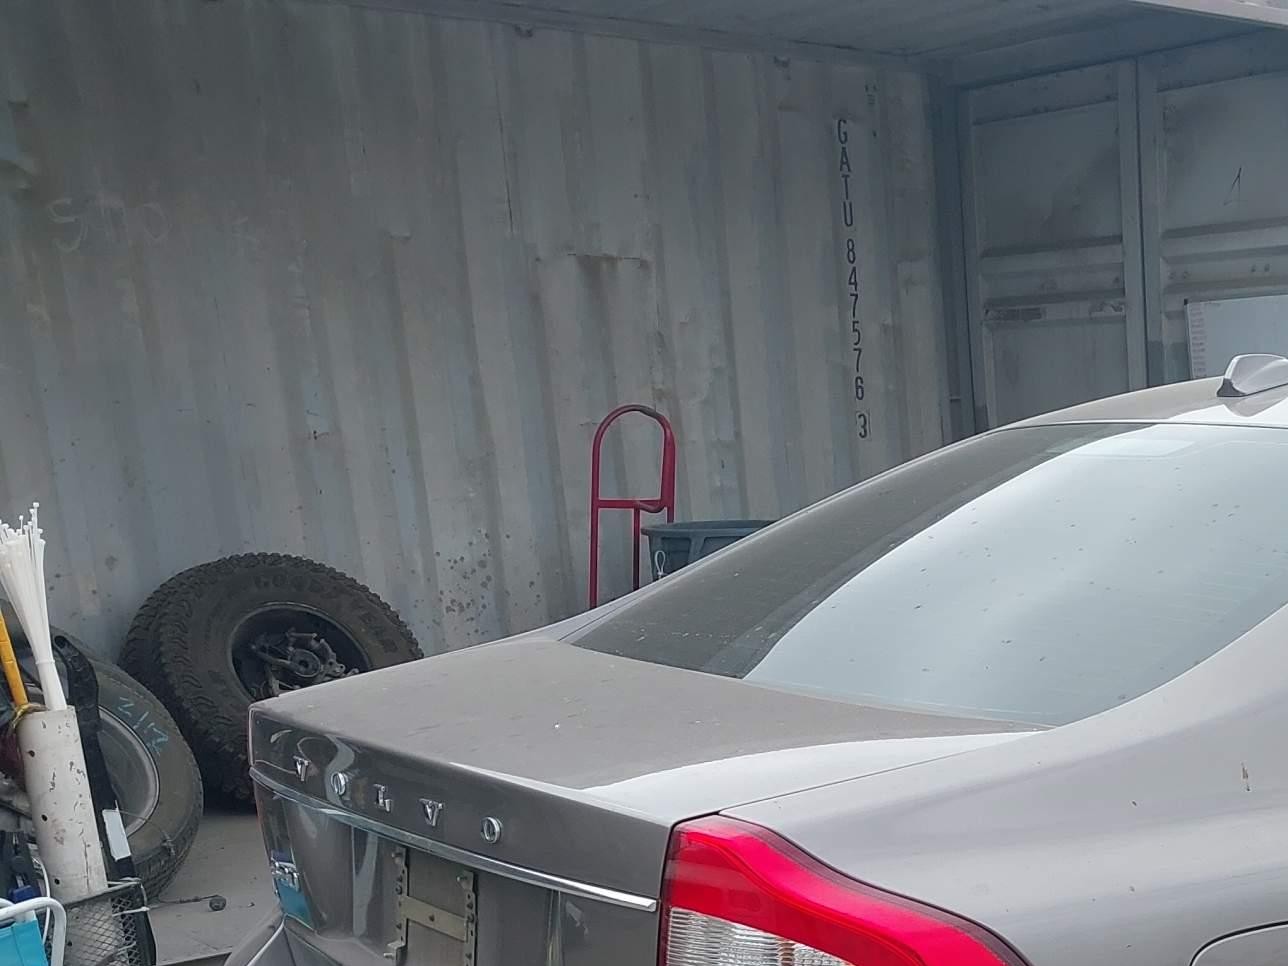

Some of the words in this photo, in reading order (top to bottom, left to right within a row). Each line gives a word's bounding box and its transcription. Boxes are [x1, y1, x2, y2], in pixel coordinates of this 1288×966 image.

[837, 118, 854, 227] GATU
[847, 238, 866, 401] 847576
[857, 413, 868, 439] 3
[292, 755, 503, 844] VOLVO
